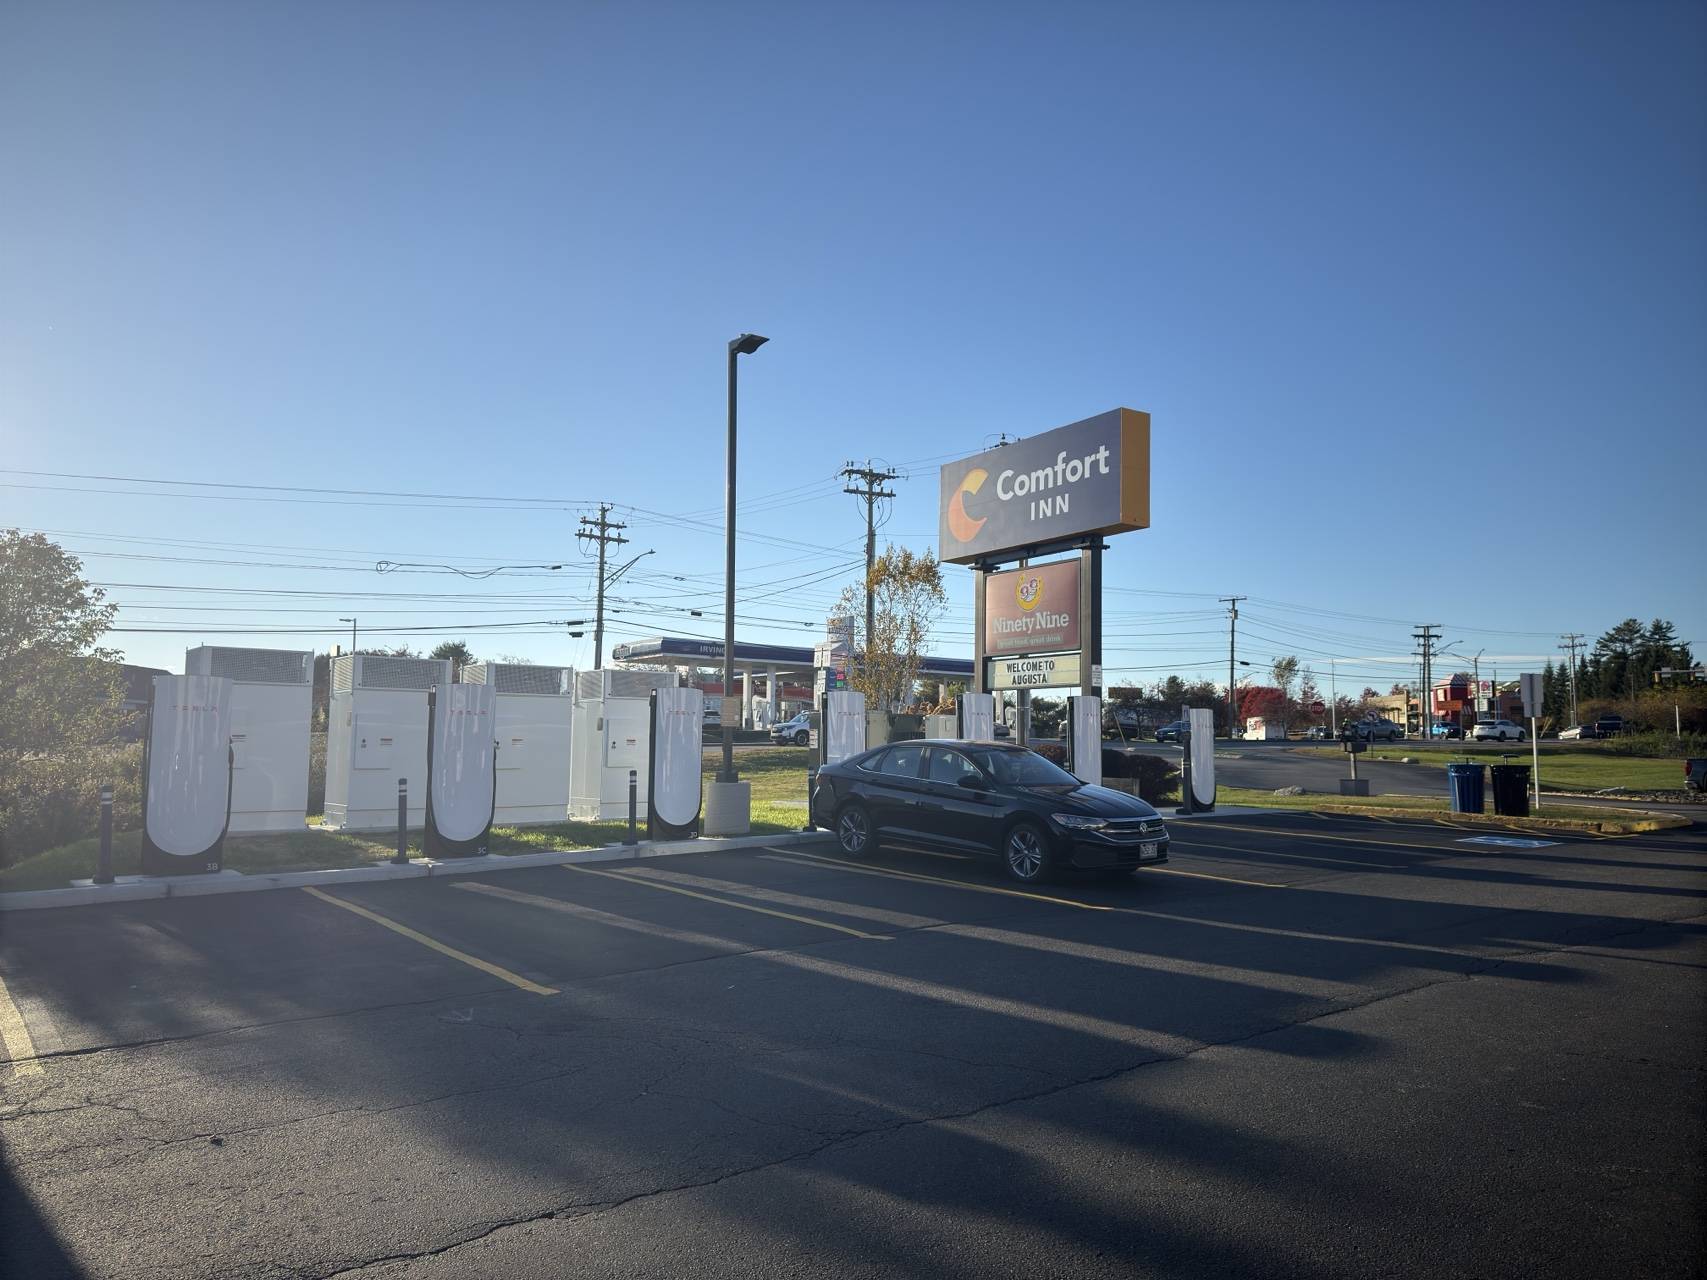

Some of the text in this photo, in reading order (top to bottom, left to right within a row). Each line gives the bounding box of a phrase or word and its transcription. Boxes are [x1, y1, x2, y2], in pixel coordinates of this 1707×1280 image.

[996, 445, 1110, 501] Comfort
[1030, 494, 1069, 521] INN
[991, 611, 1069, 634] Ninety Nine
[1006, 660, 1055, 673] WELCOME TO
[1011, 673, 1047, 685] AUGUSTA
